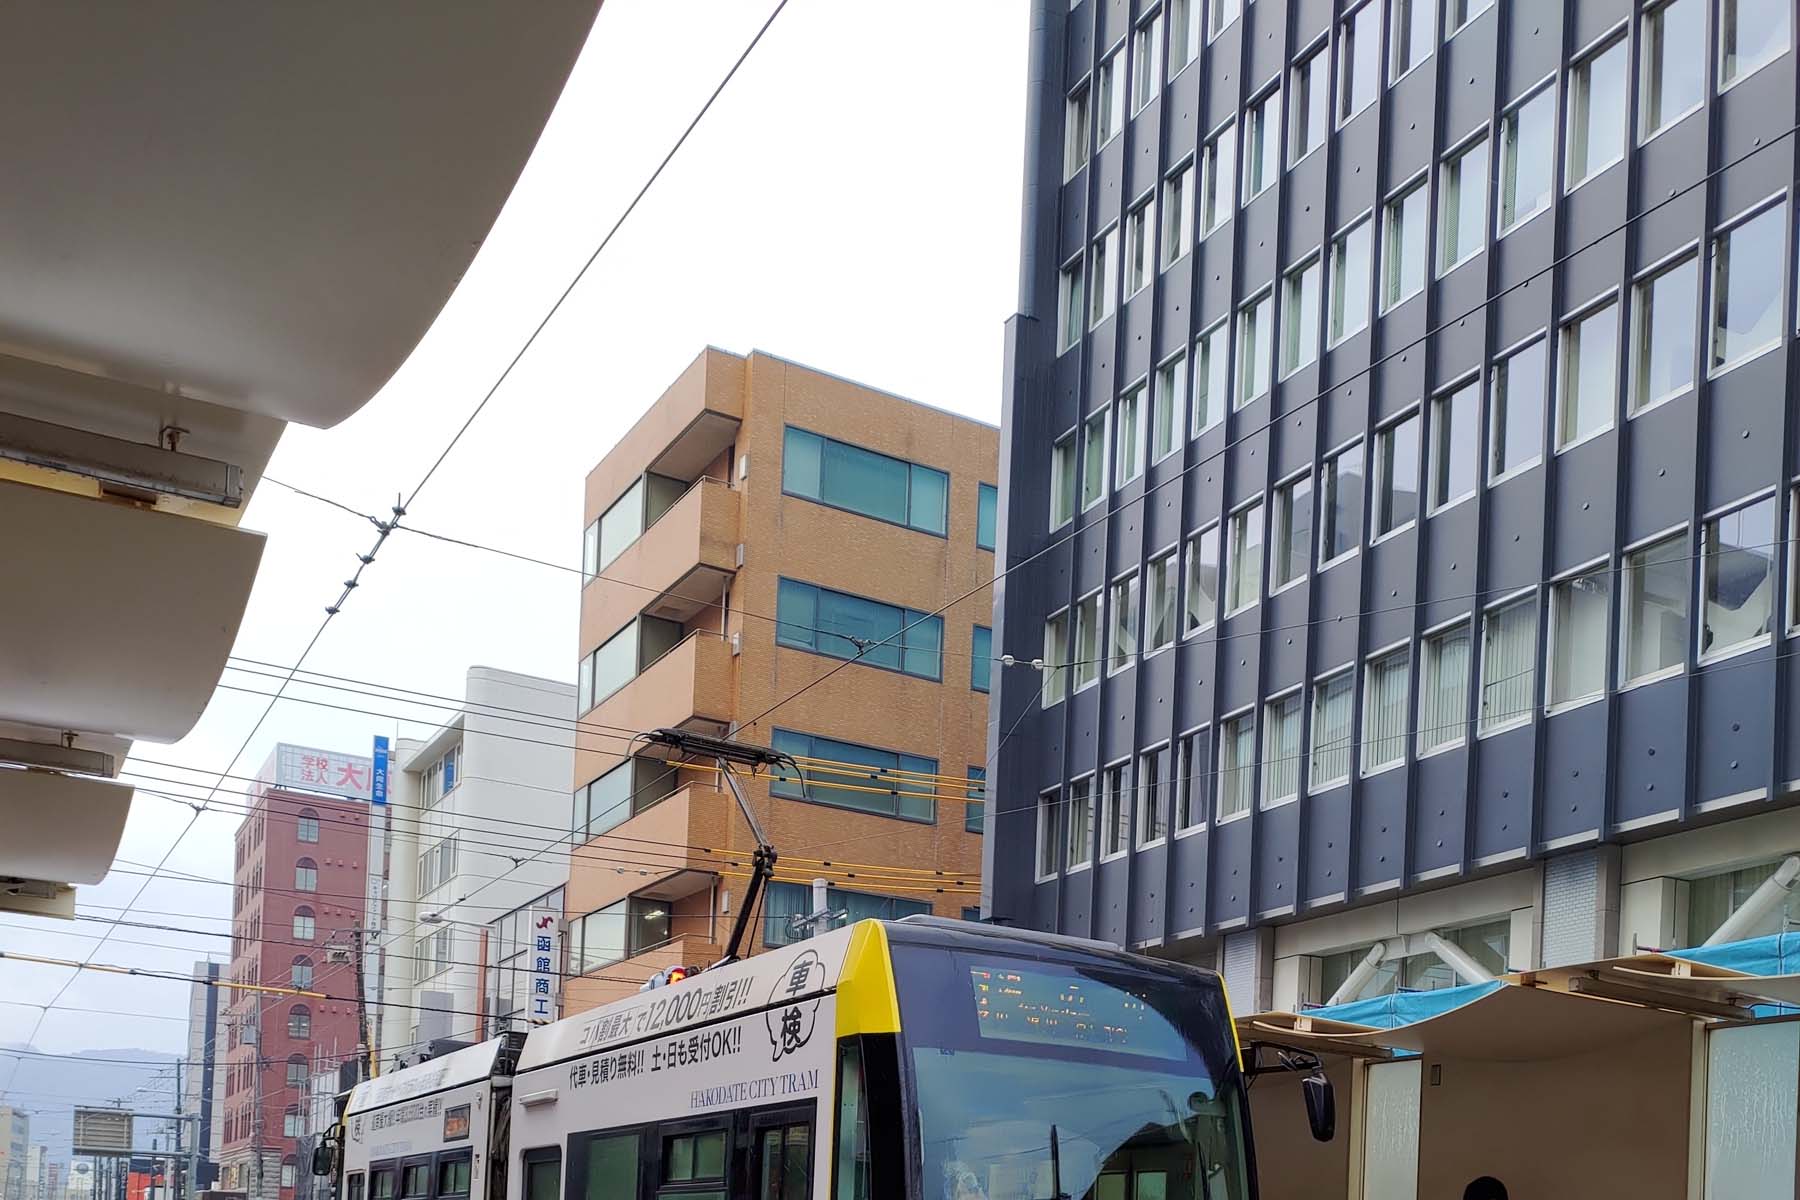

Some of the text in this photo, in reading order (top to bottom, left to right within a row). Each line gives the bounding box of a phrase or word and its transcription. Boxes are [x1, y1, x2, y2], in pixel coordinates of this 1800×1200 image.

[781, 960, 813, 1047] 車検
[690, 1069, 819, 1109] HAKODATE CITY TRAM
